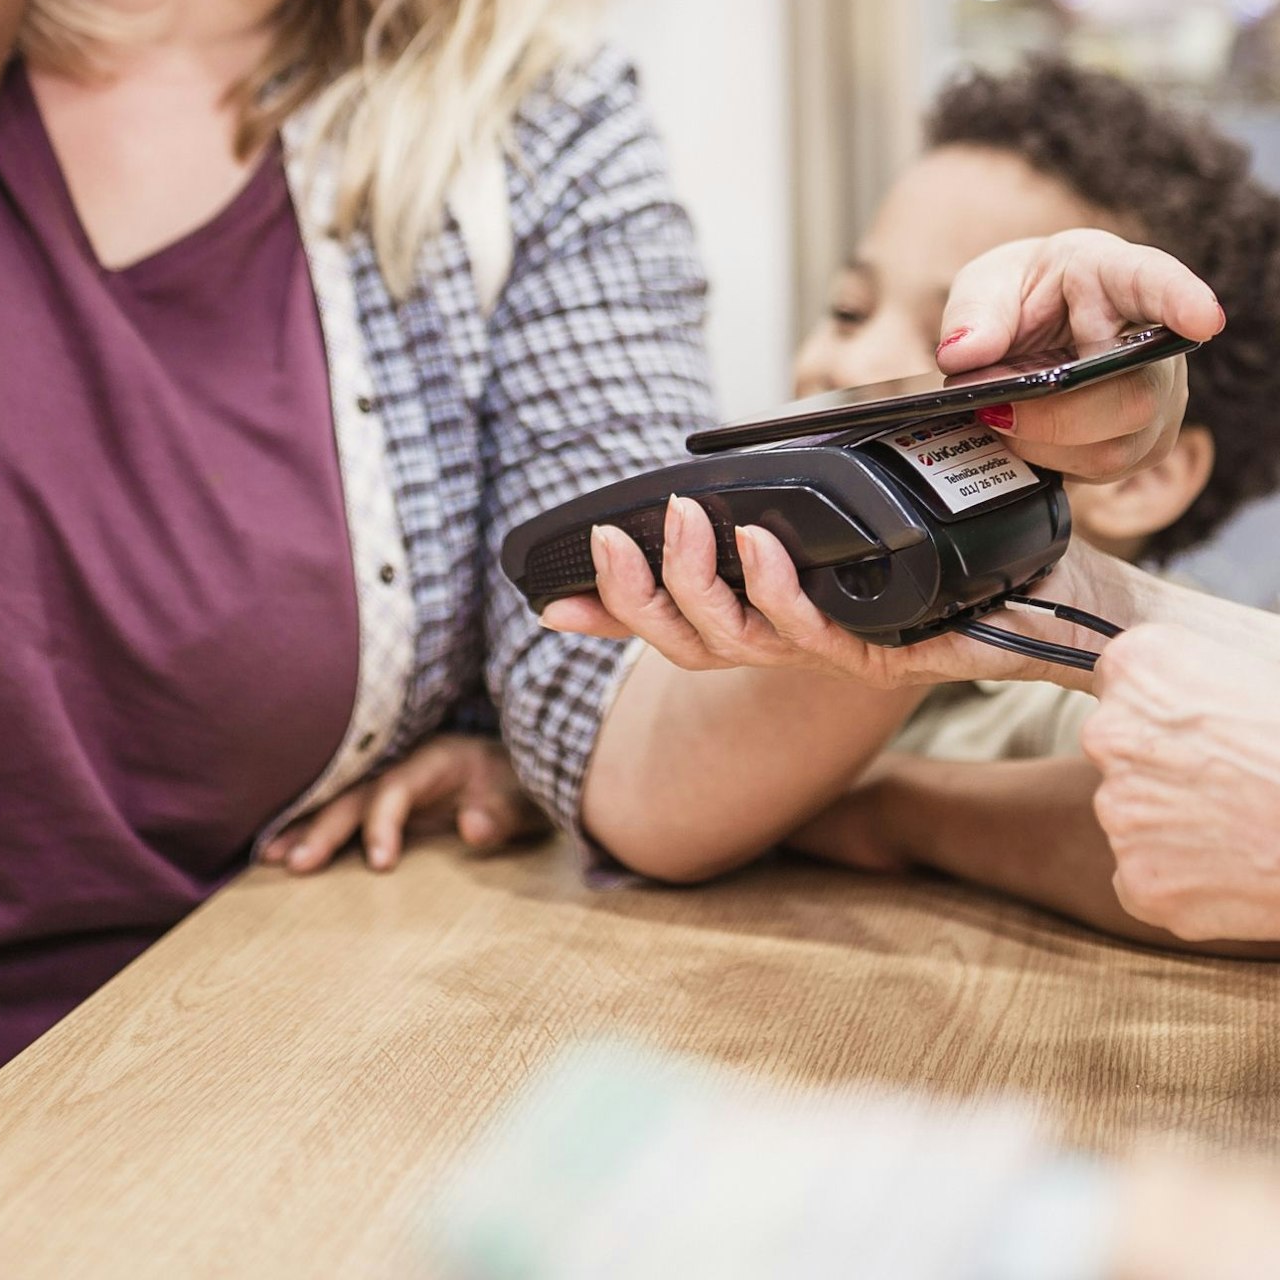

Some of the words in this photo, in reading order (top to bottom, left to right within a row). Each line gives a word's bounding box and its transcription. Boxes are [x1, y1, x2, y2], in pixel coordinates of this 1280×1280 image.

[928, 439, 975, 462] UniCredit
[968, 433, 997, 448] Bank
[944, 466, 980, 485] Tehnička
[959, 482, 981, 497] 011/
[980, 477, 992, 489] 26
[990, 474, 1002, 486] 76
[1001, 469, 1018, 482] 714
